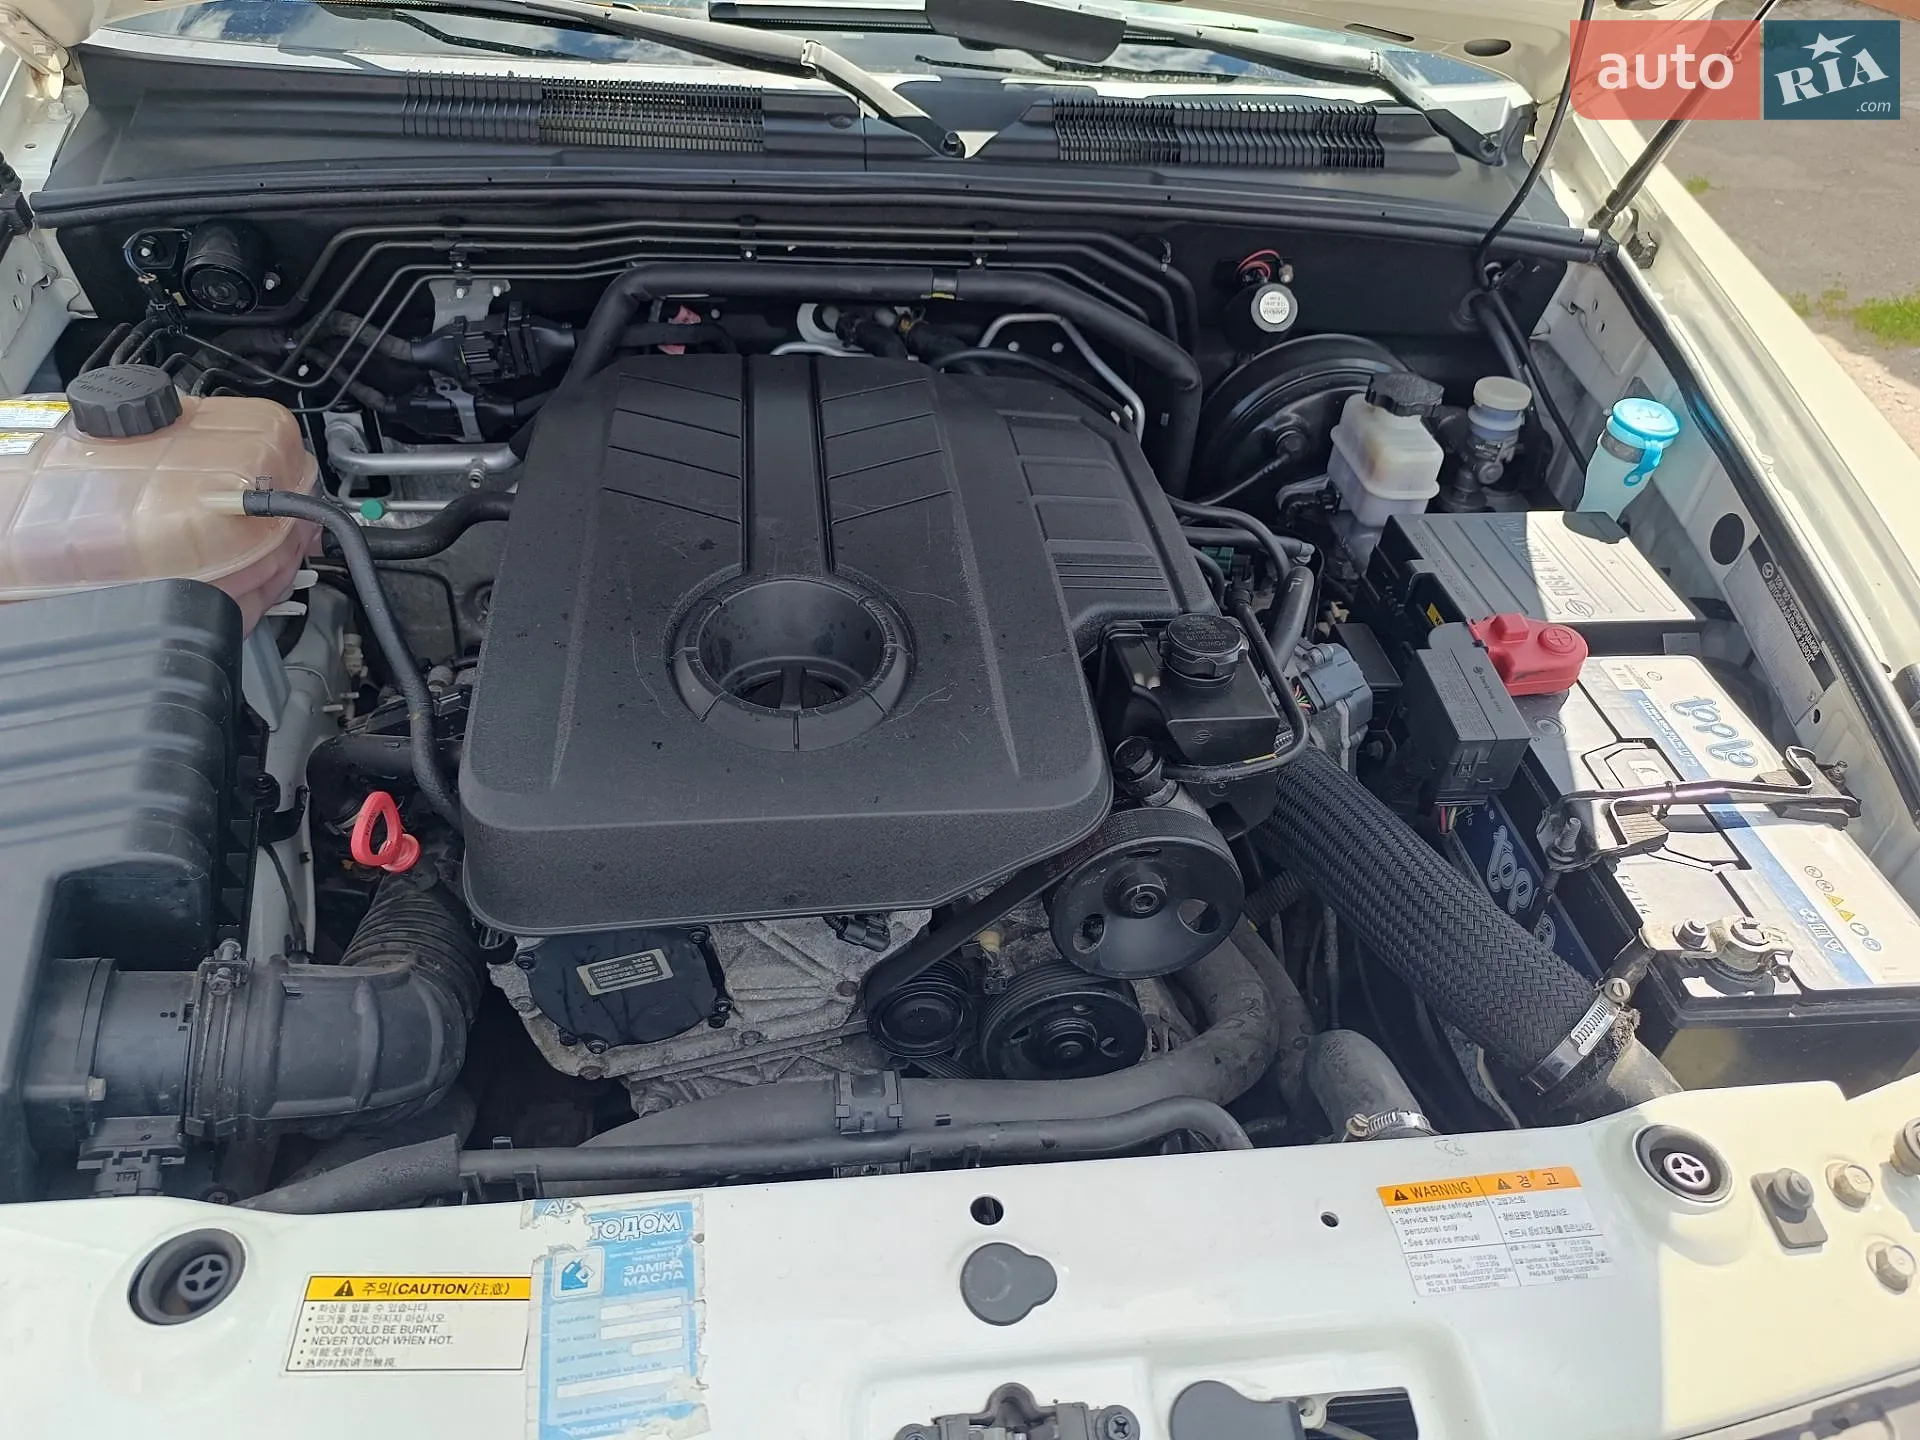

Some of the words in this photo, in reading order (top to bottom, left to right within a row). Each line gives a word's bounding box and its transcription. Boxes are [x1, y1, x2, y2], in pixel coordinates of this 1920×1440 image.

[1671, 696, 1759, 769] topla
[1487, 825, 1556, 951] topa
[1410, 1181, 1473, 1199] WARNING
[1395, 1206, 1413, 1215] High
[1414, 1204, 1446, 1213] pressure
[1448, 1200, 1487, 1210] refrigerant
[1400, 1216, 1429, 1225] Service
[1430, 1214, 1438, 1223] by
[1440, 1211, 1473, 1221] qualified
[1404, 1225, 1442, 1236] personnel
[1442, 1223, 1458, 1232] only
[1408, 1238, 1423, 1247] See
[1425, 1236, 1453, 1245] service
[1454, 1233, 1480, 1243] manual
[623, 1259, 684, 1276] ЗАМІНА
[623, 1271, 685, 1287] МАСЛА
[314, 1325, 338, 1335] YOU
[340, 1325, 380, 1335] COULD
[382, 1325, 398, 1335] BE
[400, 1325, 439, 1335] BURNT.
[311, 1336, 347, 1346] NEVER
[351, 1336, 390, 1346] TOUCH
[393, 1336, 426, 1346] WHEN
[428, 1335, 454, 1345] HOT.
